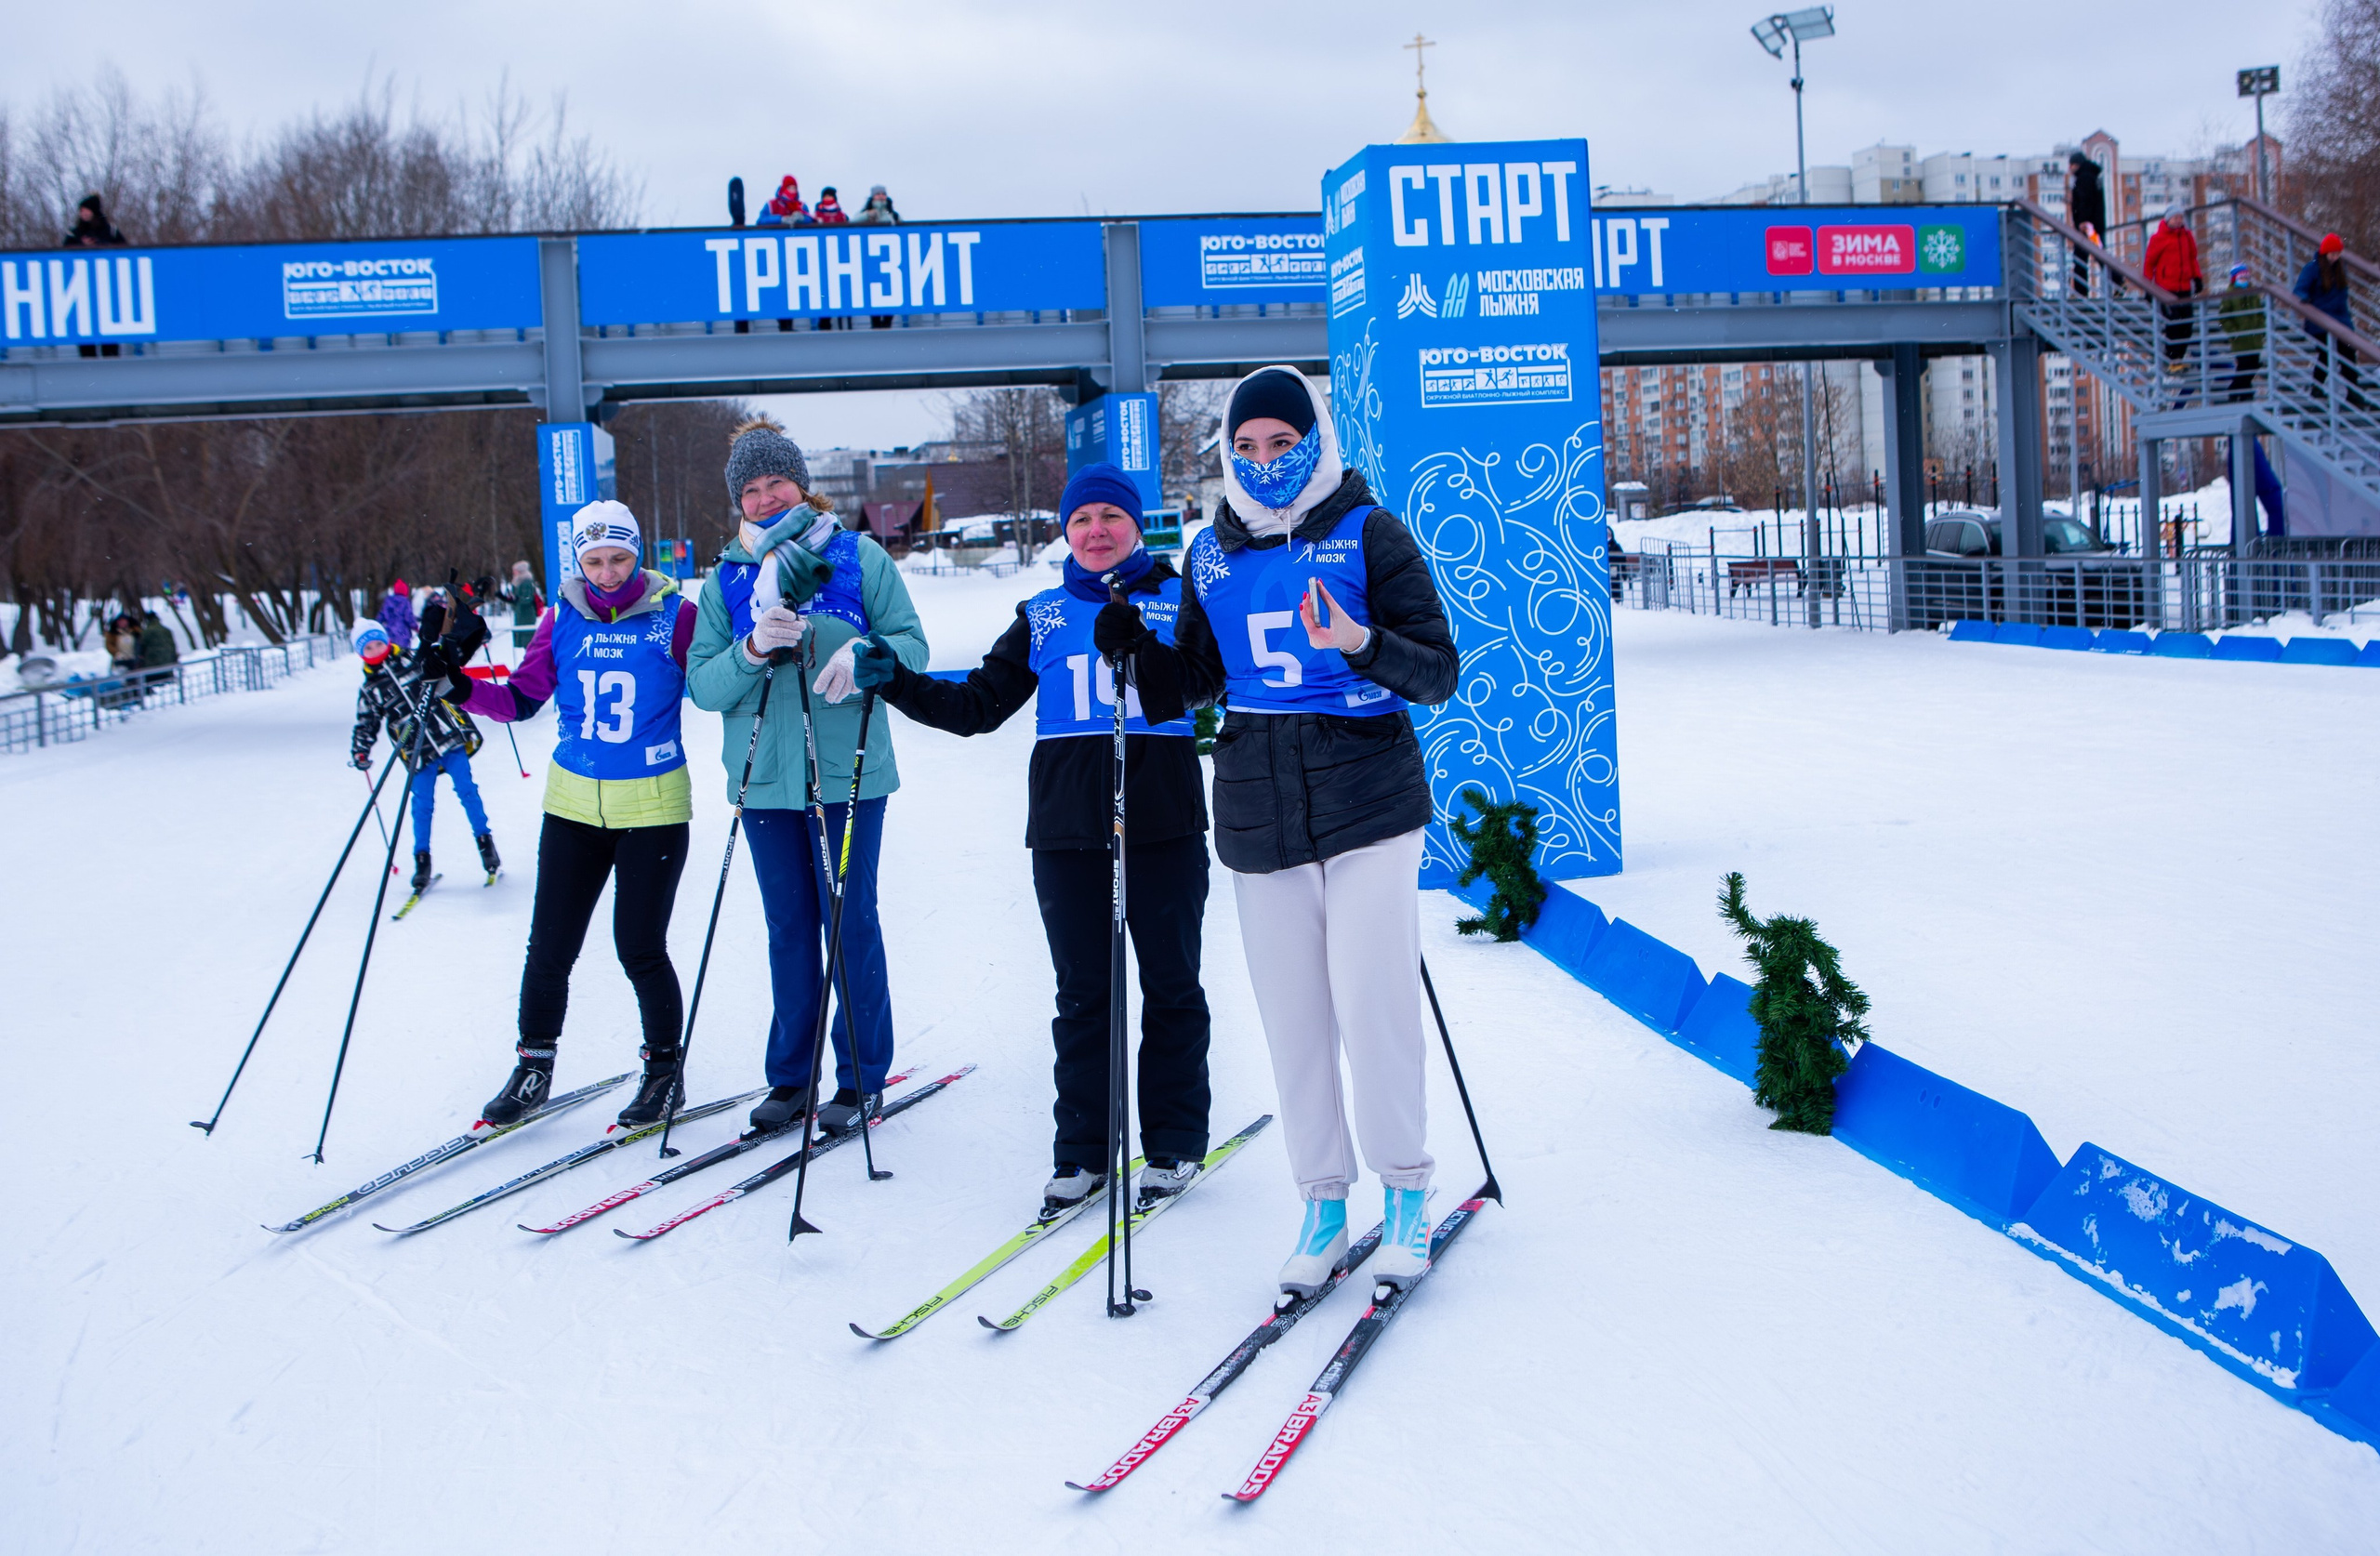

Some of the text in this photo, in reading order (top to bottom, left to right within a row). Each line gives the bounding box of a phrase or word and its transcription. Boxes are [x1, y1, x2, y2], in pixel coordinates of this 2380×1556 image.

[1389, 161, 1577, 246] СТАРТ
[1831, 234, 1900, 253] ЗИМА
[283, 258, 433, 278] ЮГО-ВОСТОК
[1832, 254, 1901, 266] В МОСКВЕ
[705, 231, 980, 313] ТРАНЗИТ
[1477, 268, 1585, 293] МОСКОВСКАЯ
[1, 257, 156, 338] НИШ
[1479, 293, 1540, 317] ЛЫЖНЯ
[1420, 344, 1568, 365] ЮГО-ВОСТОК
[1531, 389, 1566, 397] КОМПЛЕКС
[1119, 401, 1130, 470] ЮГО-ВОСТОК
[1317, 539, 1358, 550] ЛЫЖНЯ
[1316, 553, 1346, 563] МОЭК
[1146, 612, 1173, 623] МОЭК
[595, 633, 637, 644] ЛЫЖНЯ
[594, 648, 623, 658] МОЭК
[1247, 611, 1302, 688] 5
[577, 670, 636, 744] 13
[820, 836, 829, 871] SPORT
[625, 1123, 668, 1143] FISCHER
[304, 1195, 350, 1221] FISCHER
[1173, 1397, 1199, 1417] A3
[1297, 1394, 1322, 1414] A3
[1092, 1417, 1183, 1487] BRADOS
[1240, 1414, 1310, 1496] BRADOS
